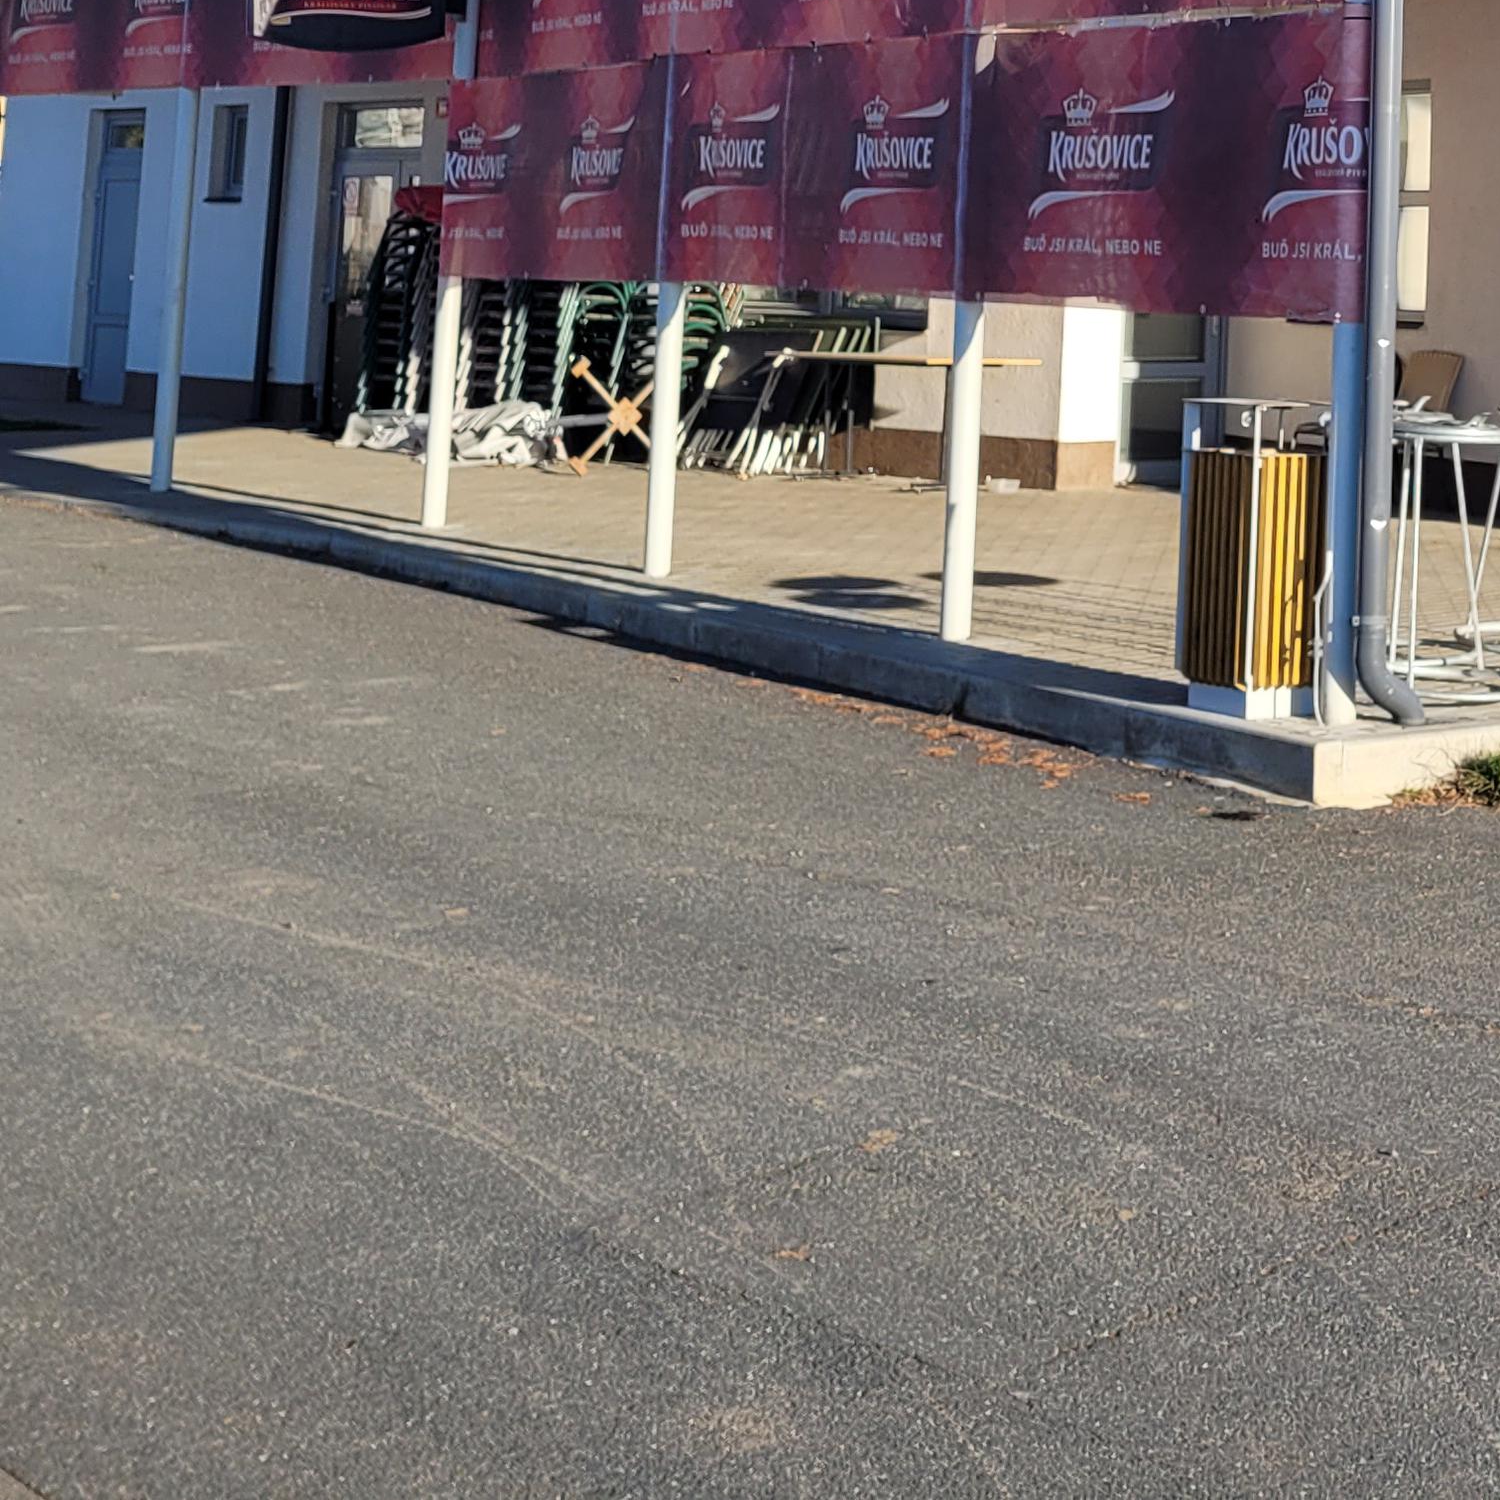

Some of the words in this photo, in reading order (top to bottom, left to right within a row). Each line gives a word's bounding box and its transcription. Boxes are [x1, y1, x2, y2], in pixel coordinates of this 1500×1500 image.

[855, 132, 935, 181] KRUŠOVICE
[1047, 128, 1153, 183] KRUŠOVICE
[1048, 237, 1066, 251] JSI
[1105, 238, 1140, 255] NEBO
[1143, 240, 1163, 256] NE
[1261, 239, 1289, 259] BUĎ
[1291, 242, 1311, 259] JSI
[1313, 239, 1363, 264] KRÁL,
